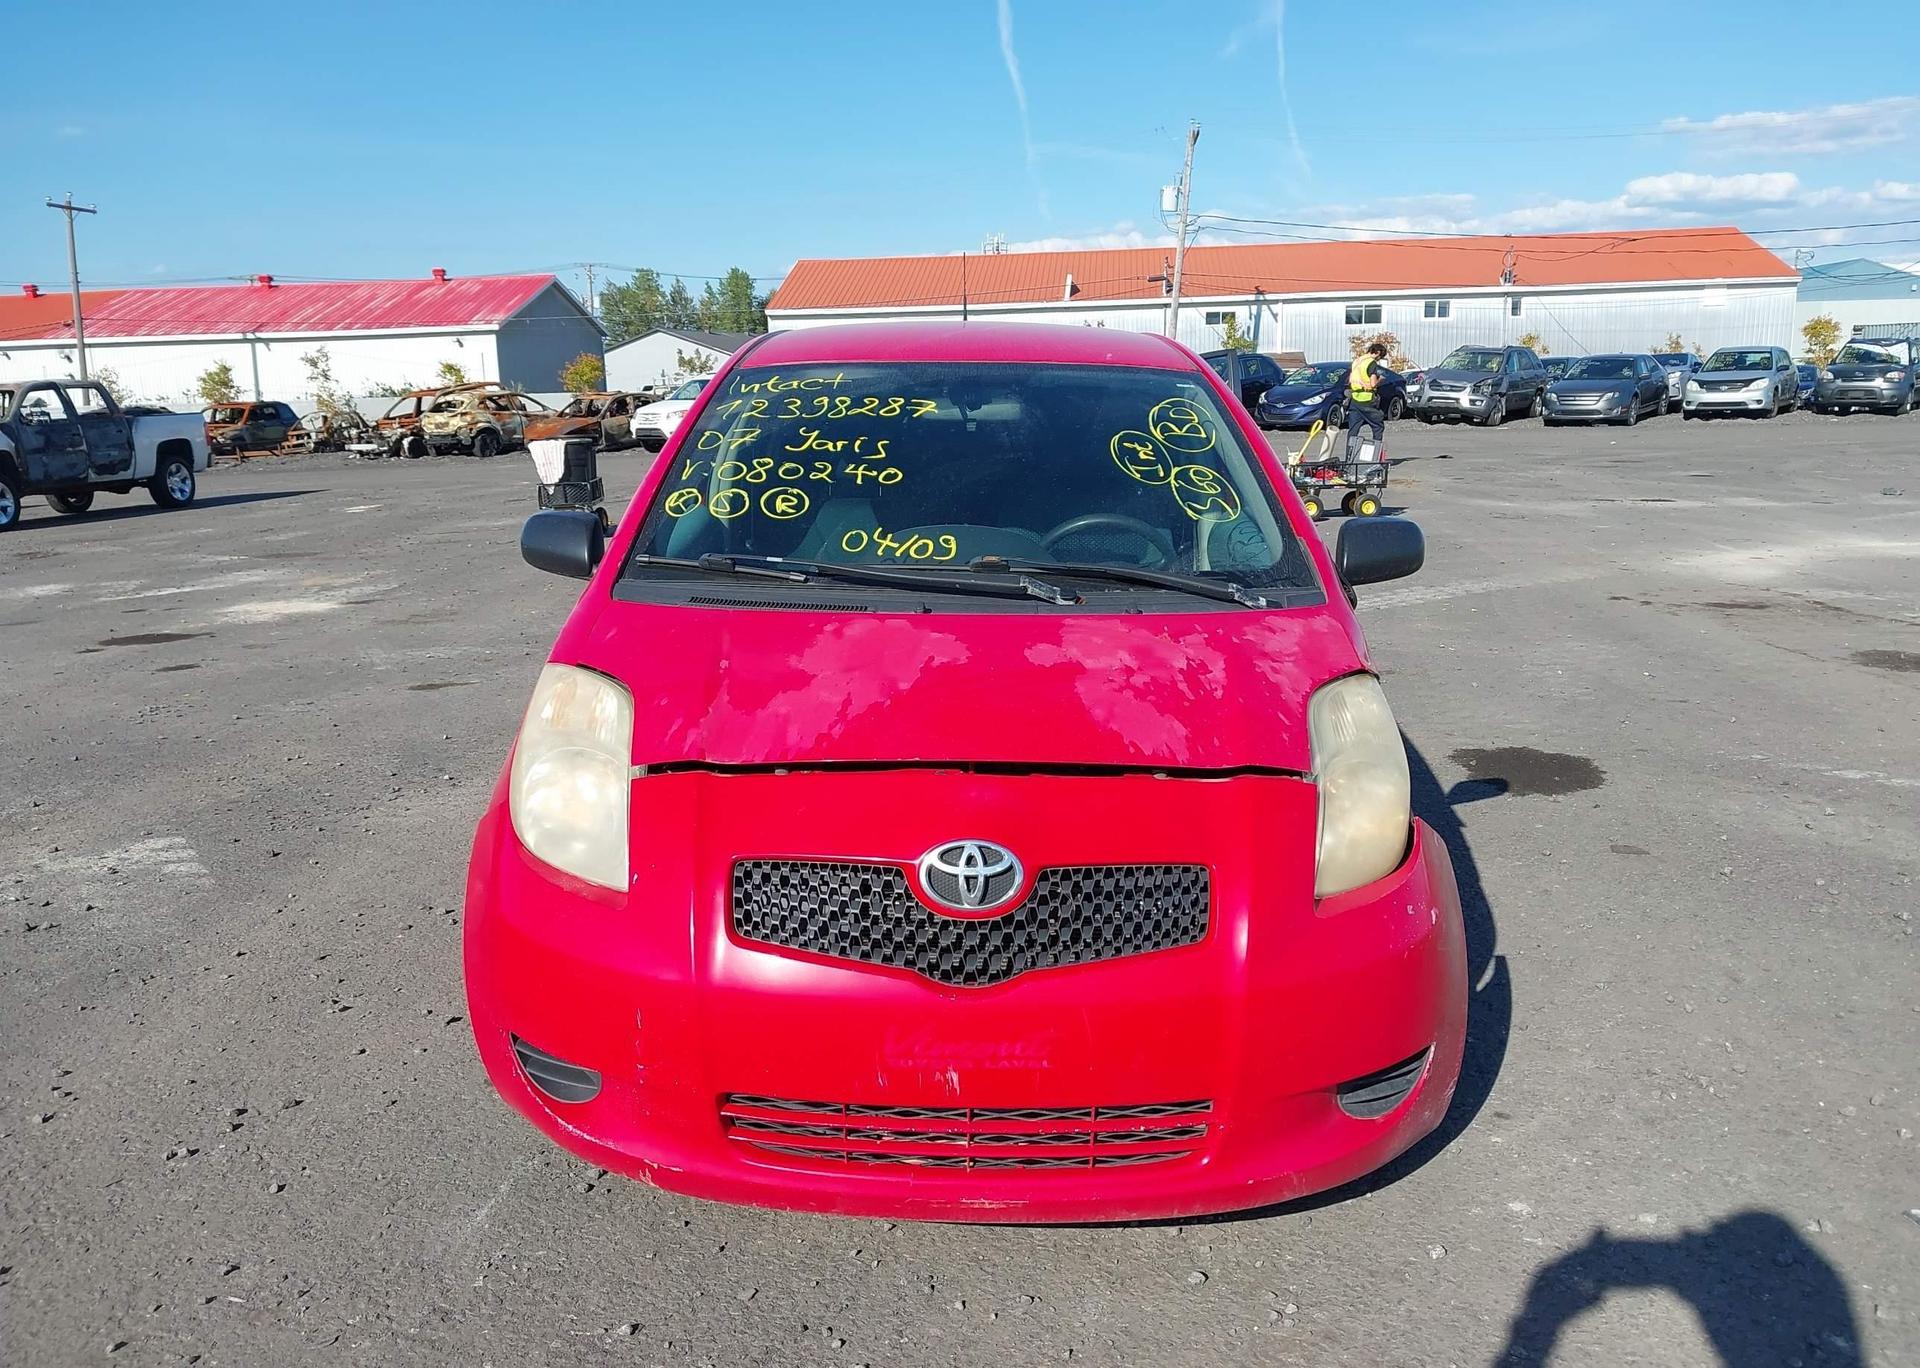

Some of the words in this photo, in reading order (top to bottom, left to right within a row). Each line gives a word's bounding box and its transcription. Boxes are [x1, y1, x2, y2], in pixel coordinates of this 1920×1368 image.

[730, 372, 852, 395] Intact
[716, 396, 938, 420] 12398287
[697, 428, 762, 450] 07
[785, 426, 890, 459] Yaris
[841, 527, 957, 560] 04/09
